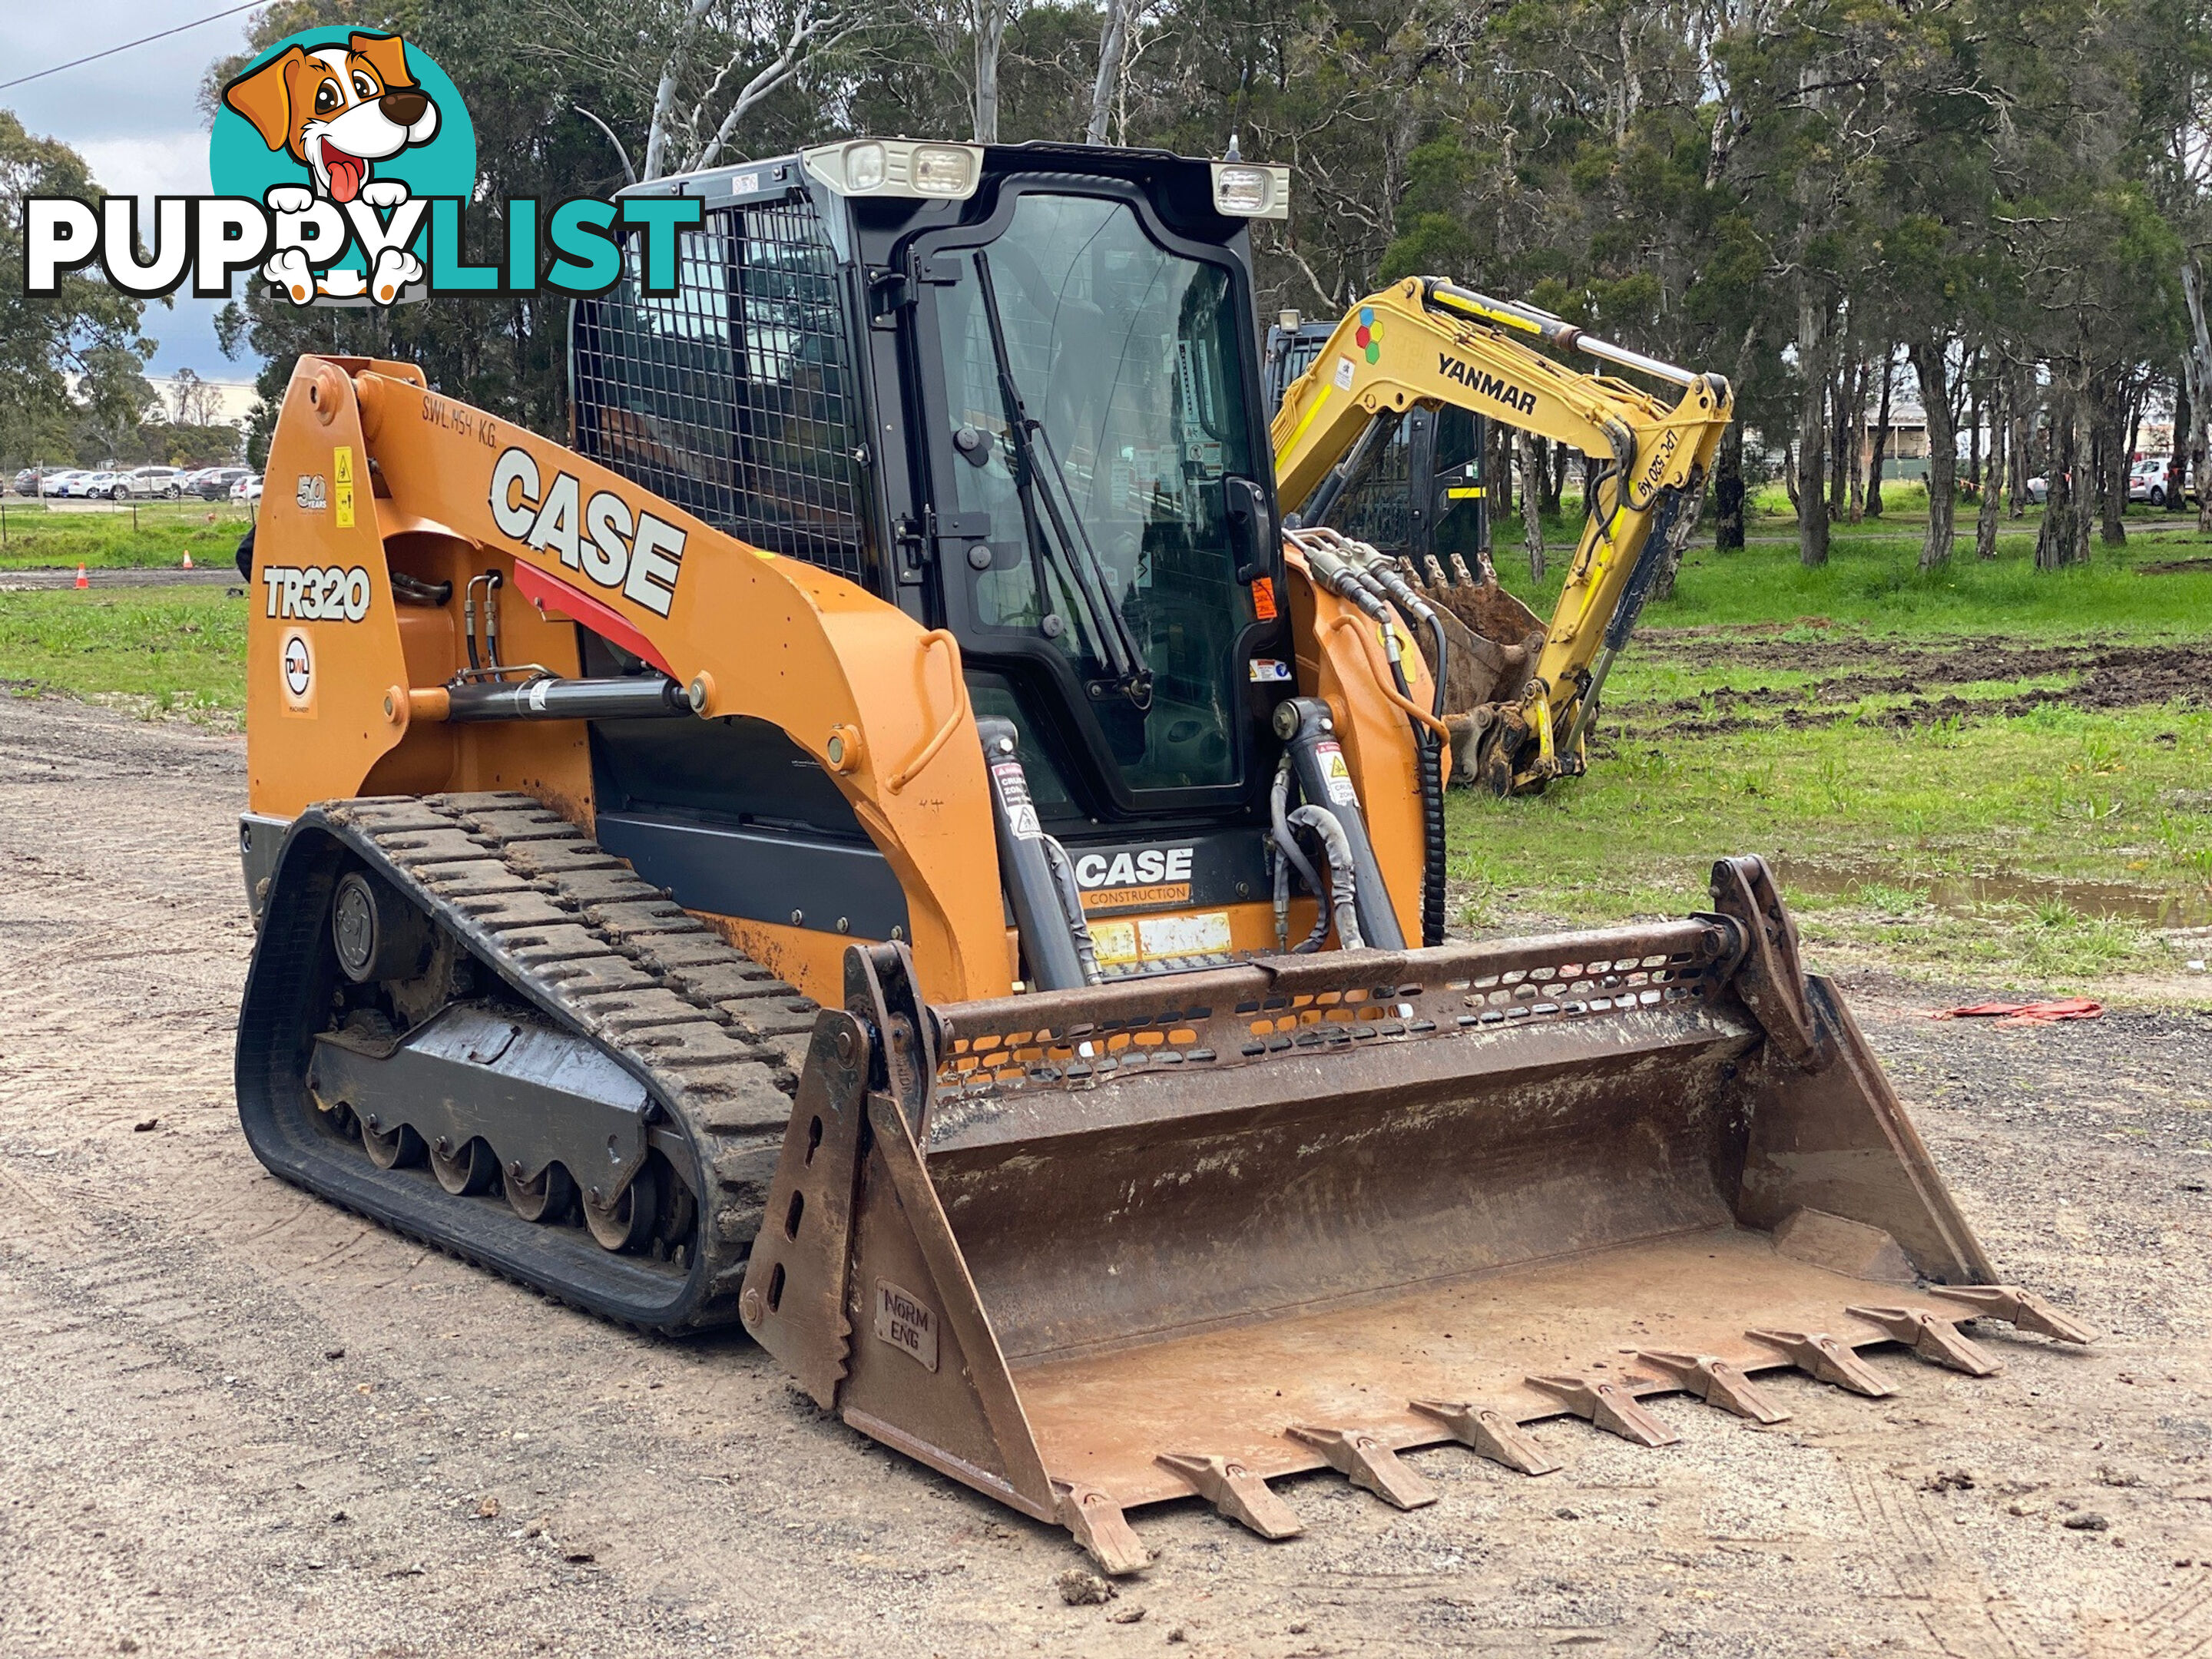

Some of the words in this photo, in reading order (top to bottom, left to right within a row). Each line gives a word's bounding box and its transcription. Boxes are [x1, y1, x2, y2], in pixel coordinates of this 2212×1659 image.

[1439, 352, 1537, 416] YANMAR
[1661, 429, 1678, 459] LPC
[1648, 454, 1664, 482] 520
[296, 473, 326, 508] 50
[308, 500, 327, 509] YEARS
[488, 445, 688, 620] CASE
[263, 565, 371, 624] TR320
[1075, 848, 1194, 888] CASE
[1090, 886, 1186, 905] CONSTRUCTION
[892, 1320, 919, 1349] ENG
